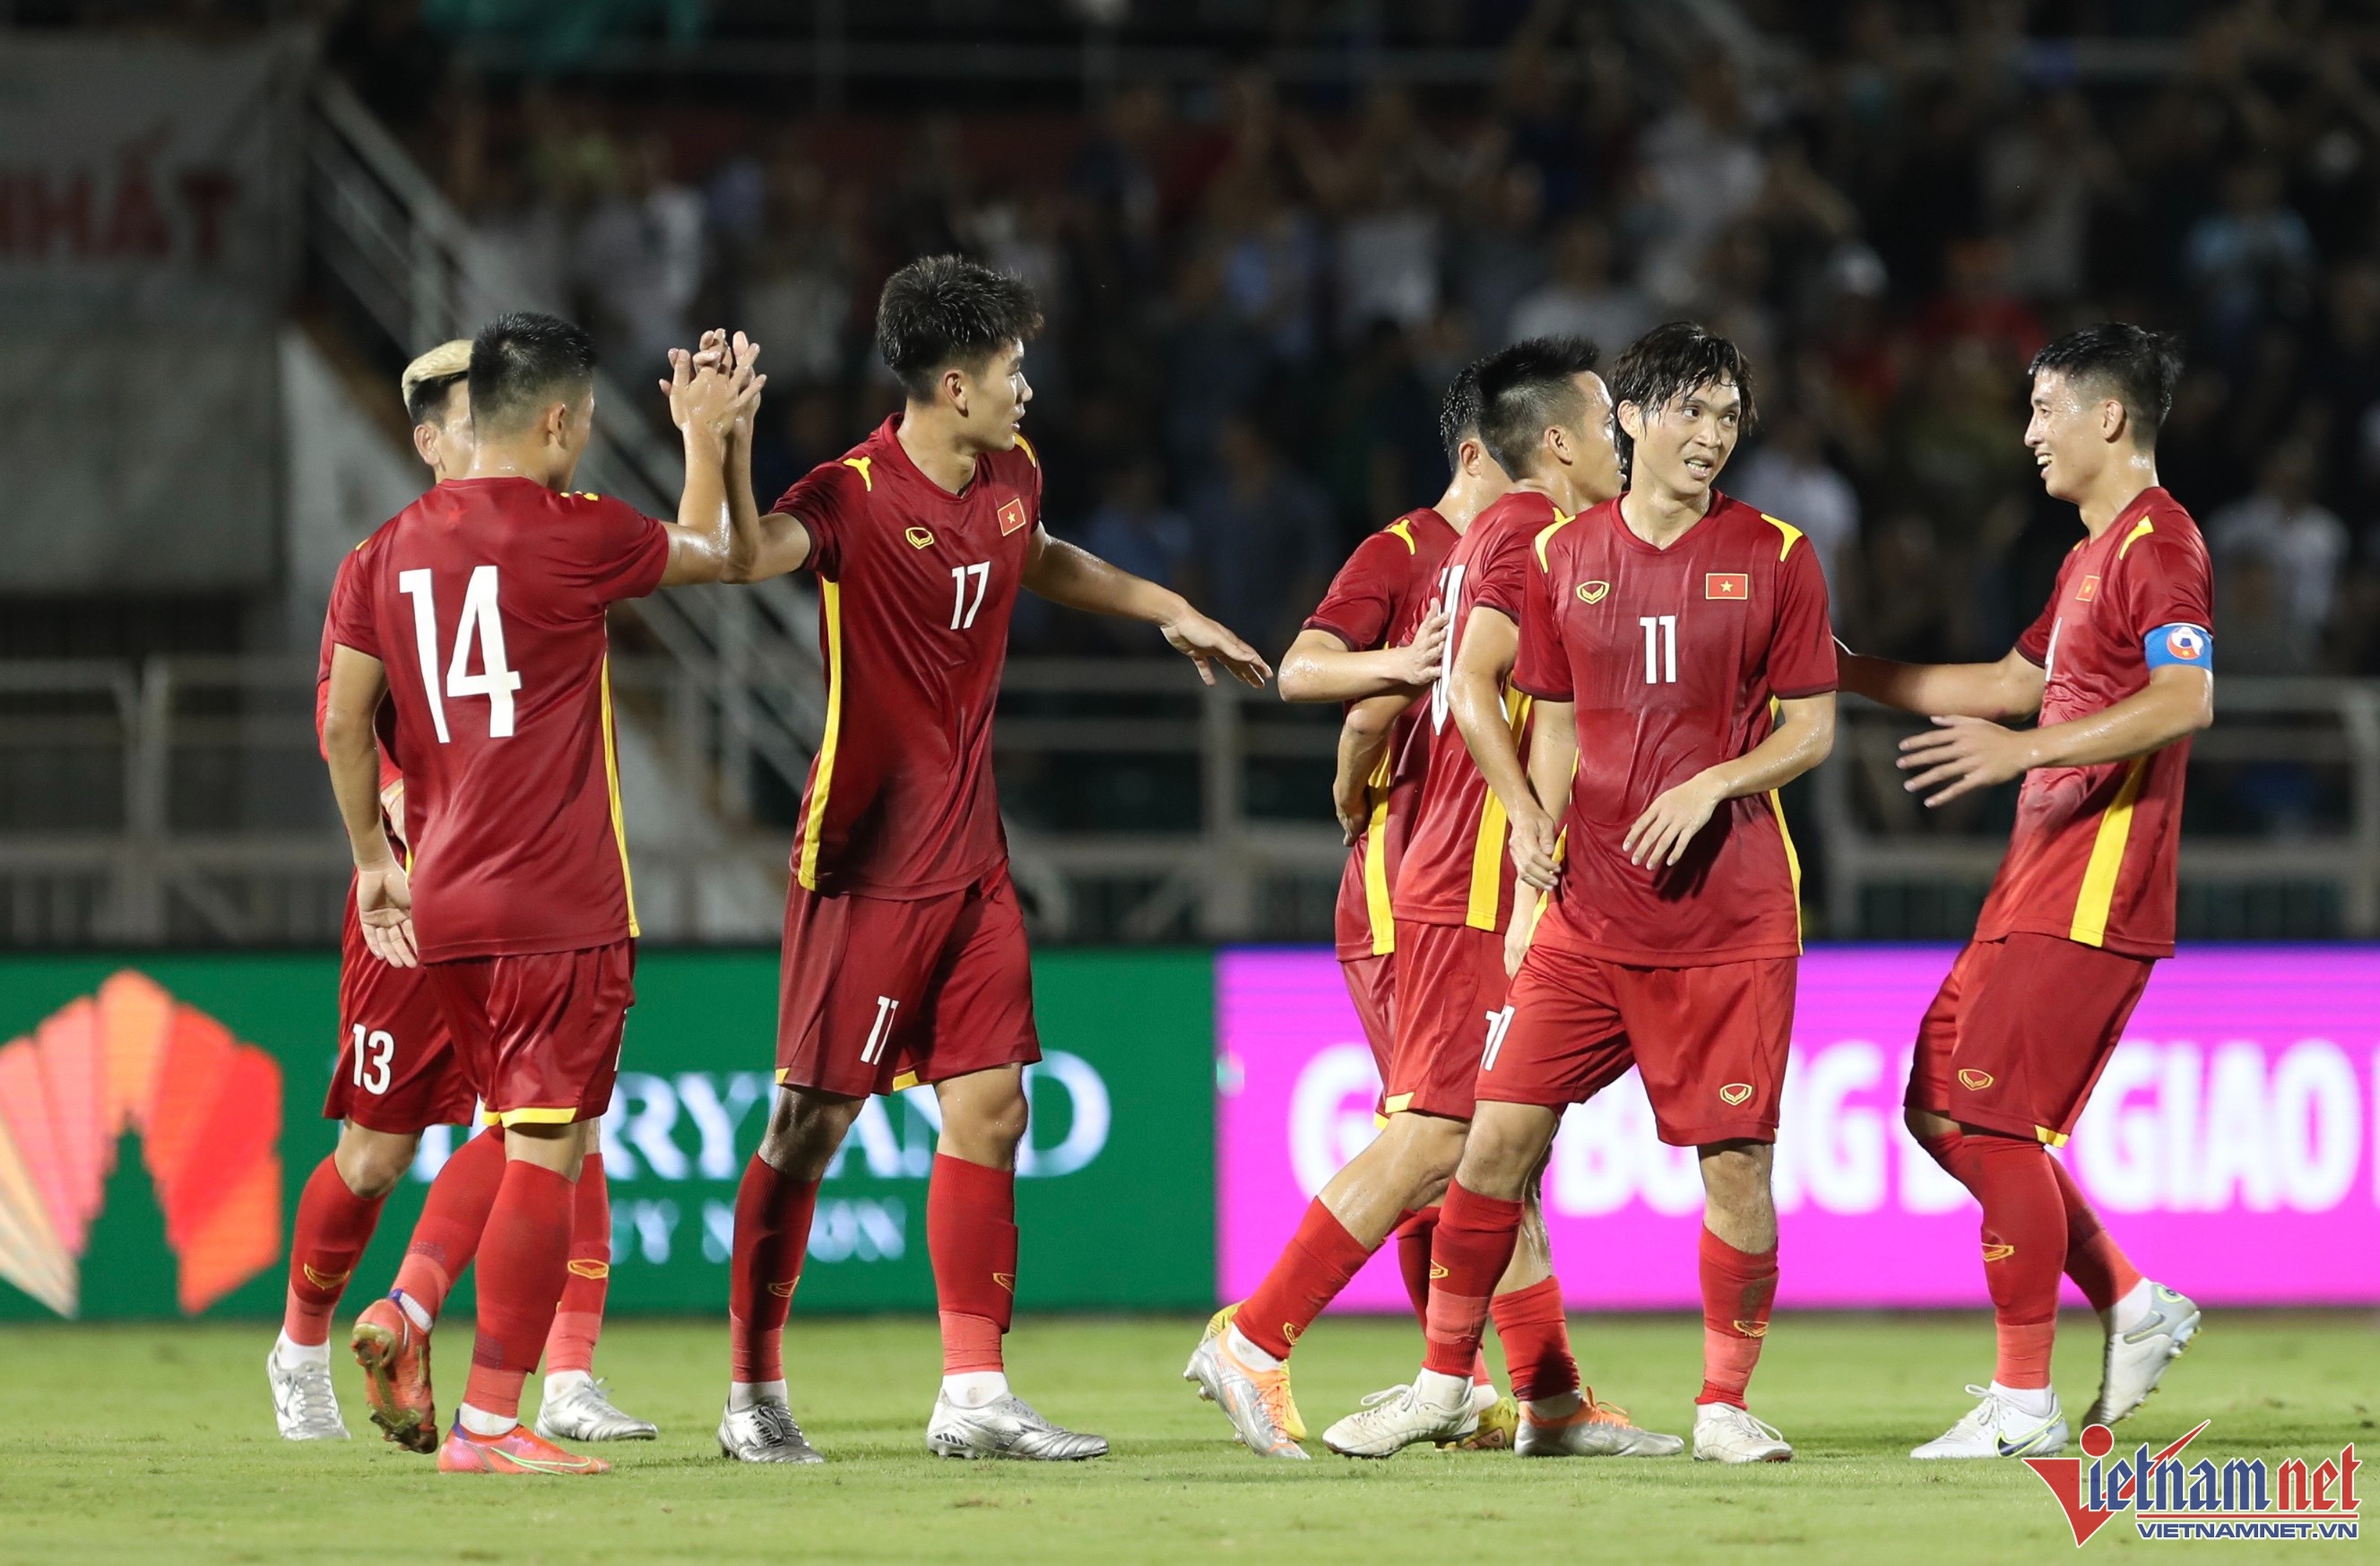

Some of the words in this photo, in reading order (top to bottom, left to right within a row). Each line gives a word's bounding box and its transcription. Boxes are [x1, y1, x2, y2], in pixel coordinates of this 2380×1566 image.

[950, 561, 991, 630] 17
[399, 566, 522, 743] 14
[1640, 615, 1676, 684] 11
[352, 1023, 394, 1095] 13
[1480, 1005, 1515, 1071] 11
[2073, 1040, 2364, 1213] GIAO
